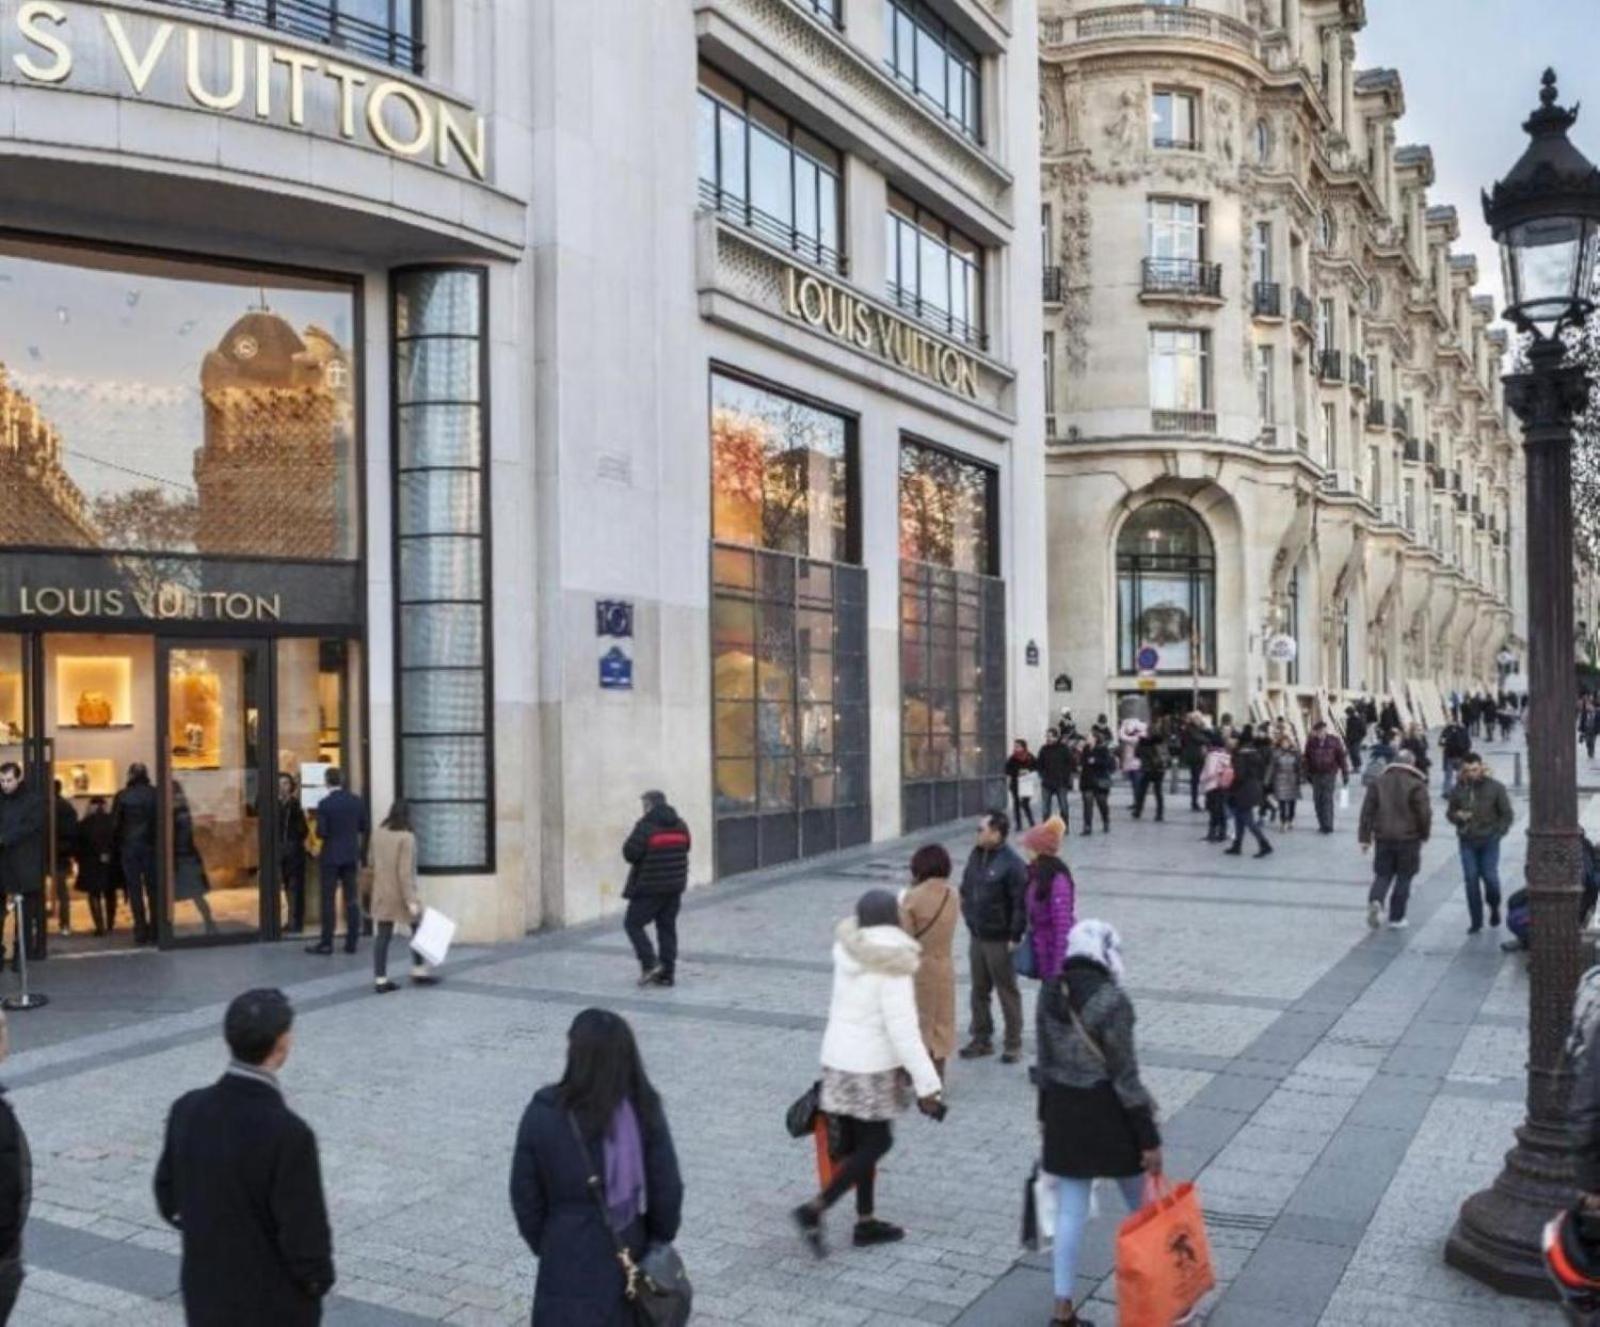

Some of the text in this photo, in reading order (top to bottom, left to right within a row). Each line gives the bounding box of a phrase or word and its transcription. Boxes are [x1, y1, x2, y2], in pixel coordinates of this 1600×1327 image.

[103, 12, 487, 180] VUITTON
[787, 267, 979, 399] LOUIS VUITTON
[20, 587, 125, 616] LOUIS
